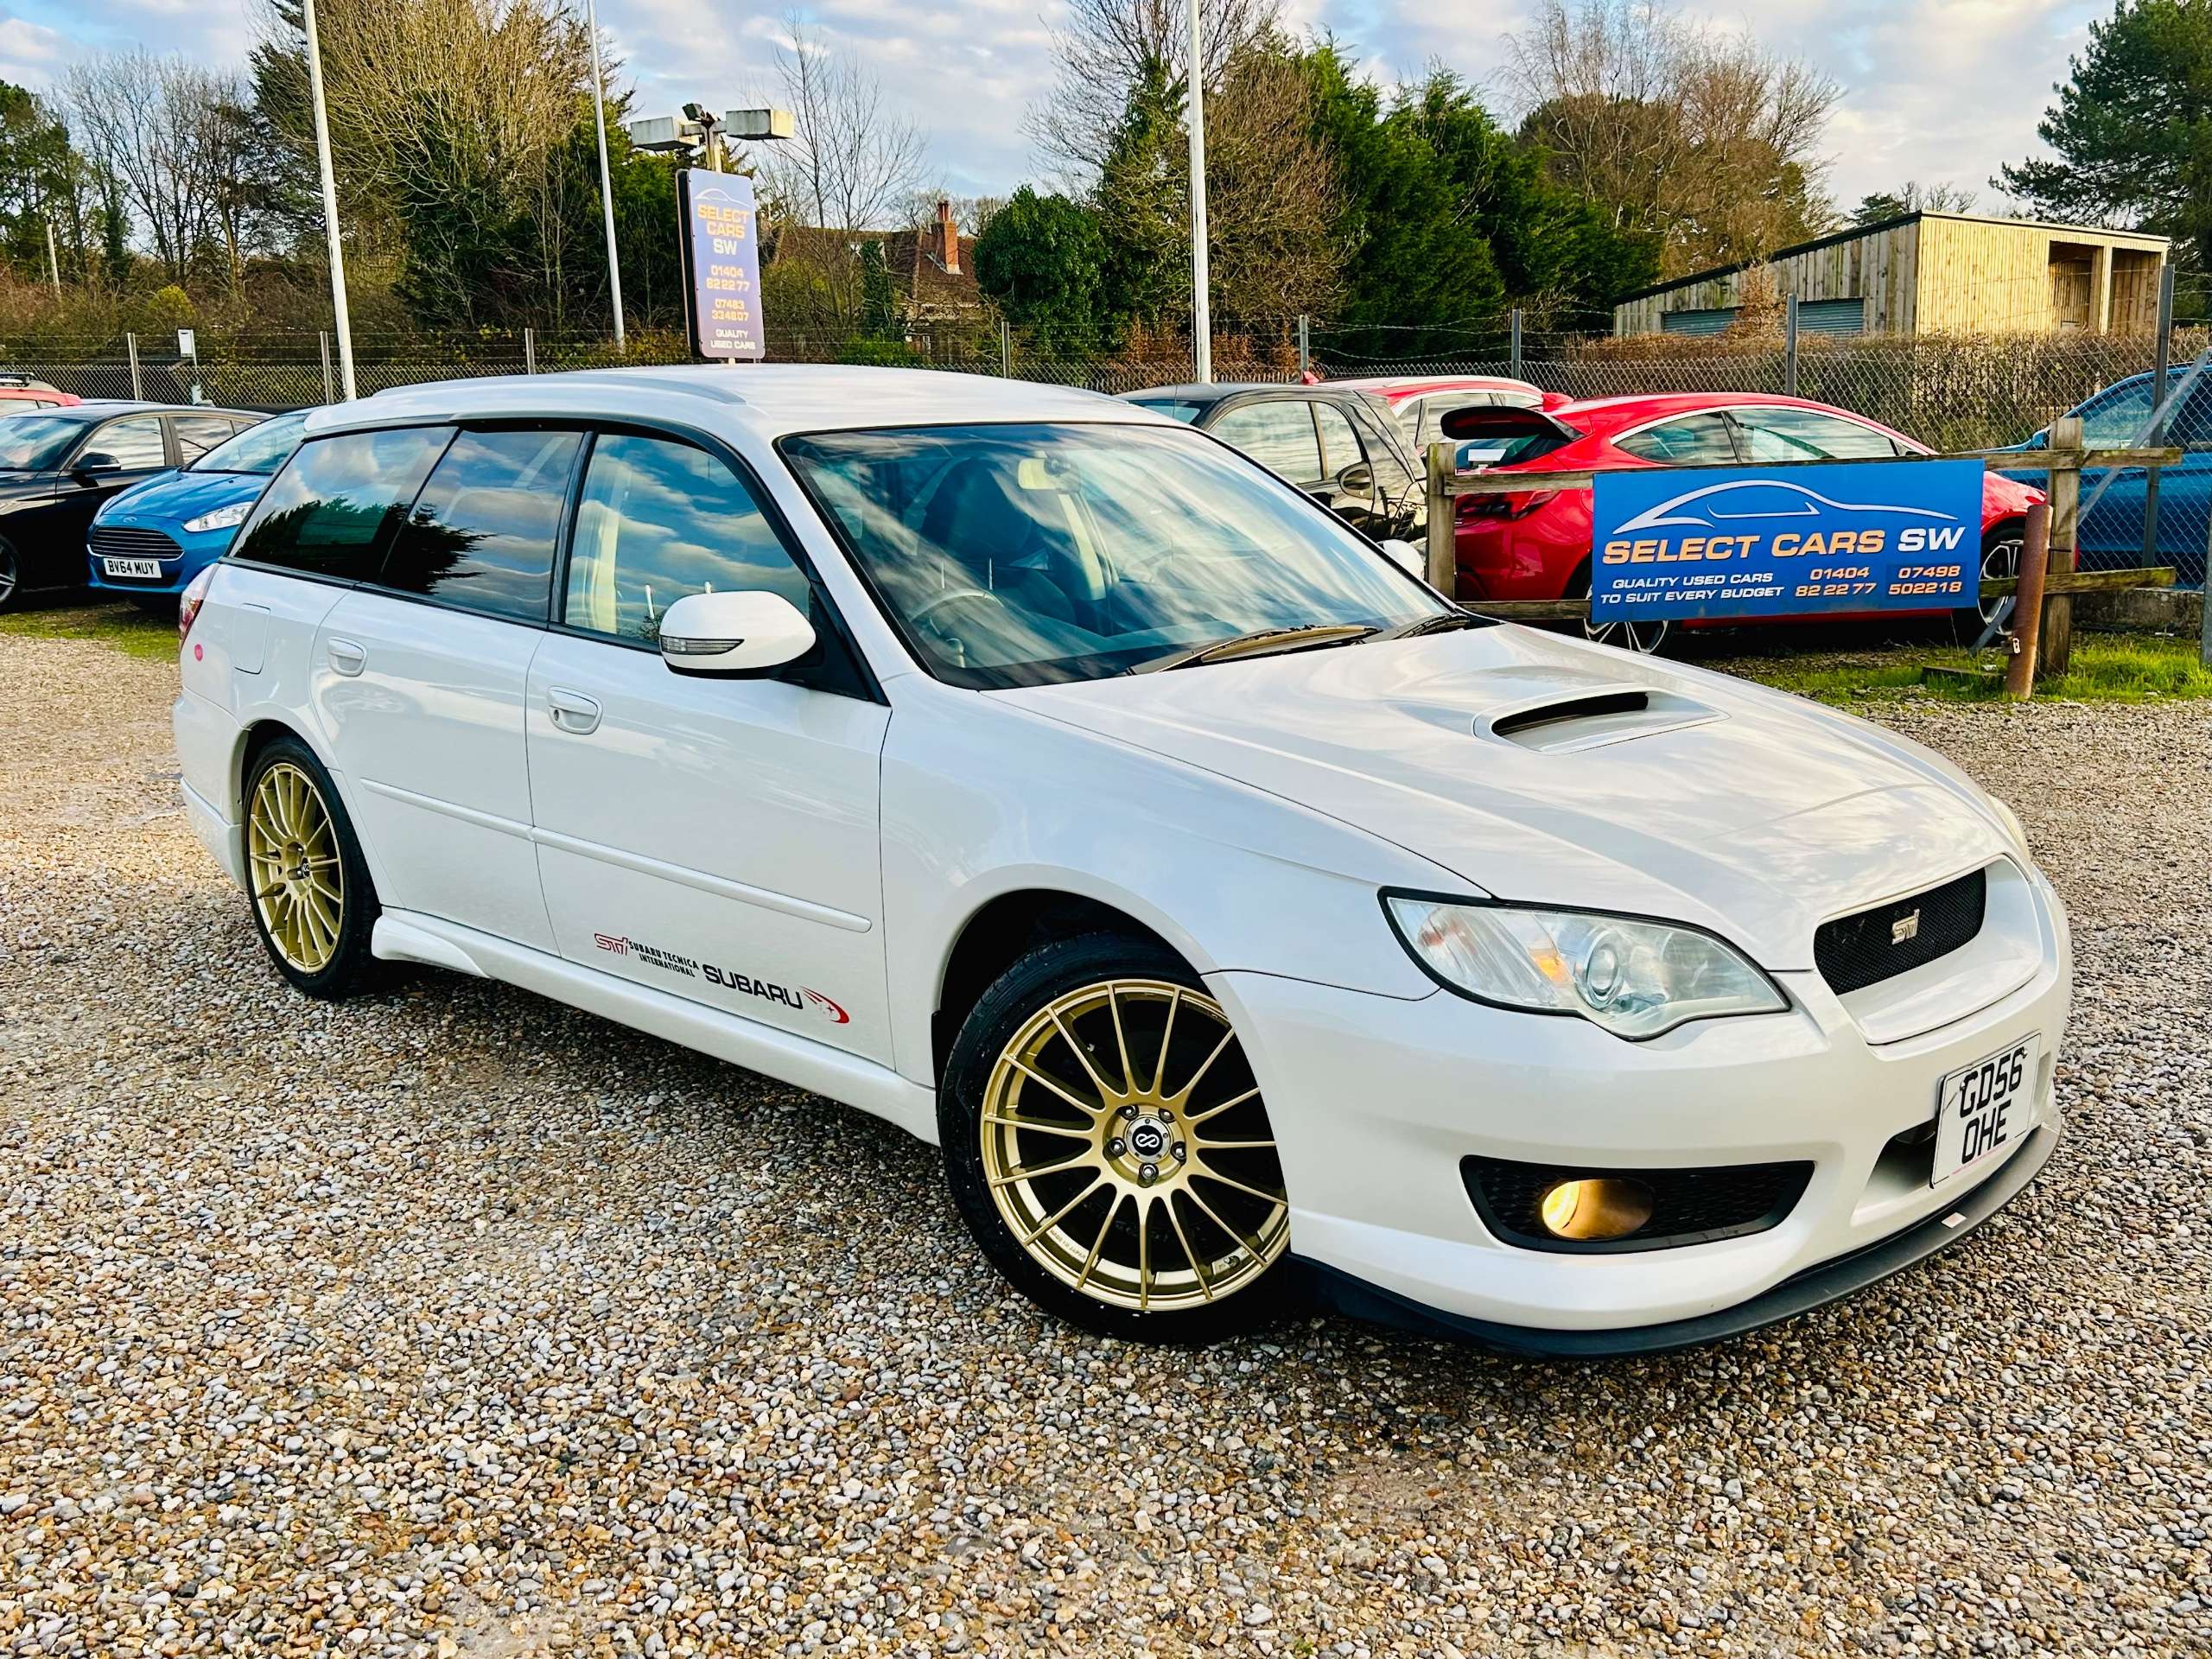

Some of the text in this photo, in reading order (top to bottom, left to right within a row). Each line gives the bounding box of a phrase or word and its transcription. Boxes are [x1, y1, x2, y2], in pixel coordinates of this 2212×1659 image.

[698, 204, 749, 224] SELECT
[707, 221, 745, 238] CARS
[713, 238, 737, 255] SW
[710, 264, 743, 277] 01404
[715, 328, 748, 339] QUALITY
[710, 340, 756, 350] USED CARS
[1602, 526, 1966, 564] SELECT CARS SW
[108, 560, 155, 575] BV64 MUY
[1809, 567, 1870, 581] 01404
[1898, 565, 1961, 579] 07498
[1612, 572, 1773, 589] QUALITY USED CARS
[1888, 582, 1962, 595] 502218
[1600, 586, 1784, 604] TO SUIT EVERY BUDGET
[629, 940, 699, 970] SUBARU TECNICA
[639, 953, 696, 978] INTERNATIONAL
[702, 963, 804, 1010] SUBARU
[1960, 1046, 2027, 1118] GD56
[1961, 1098, 2012, 1165] OHE
